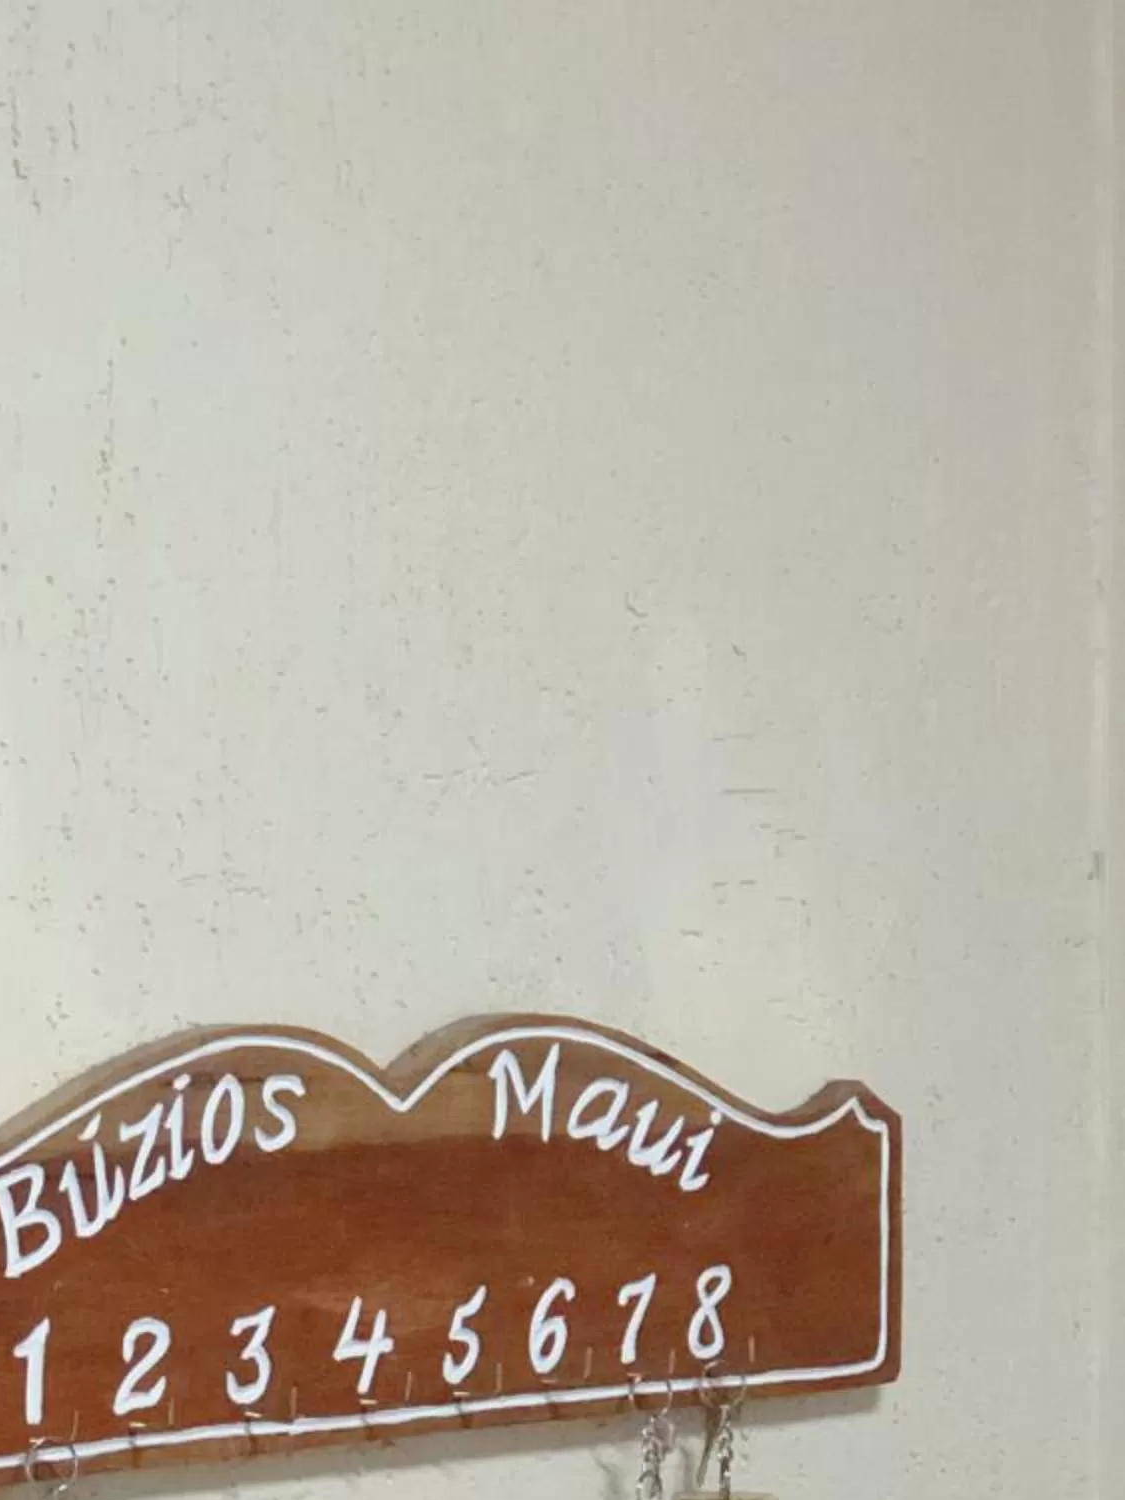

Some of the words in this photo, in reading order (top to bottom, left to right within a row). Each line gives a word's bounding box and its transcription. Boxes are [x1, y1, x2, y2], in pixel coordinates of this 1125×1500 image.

[488, 1043, 723, 1192] Maui
[13, 1316, 50, 1425] 1
[113, 1318, 171, 1416] 2
[225, 1304, 276, 1404] 3
[332, 1296, 394, 1395] 4
[442, 1285, 487, 1386] 5
[528, 1277, 576, 1374] 6
[618, 1273, 656, 1364] 7
[688, 1264, 732, 1360] 8
